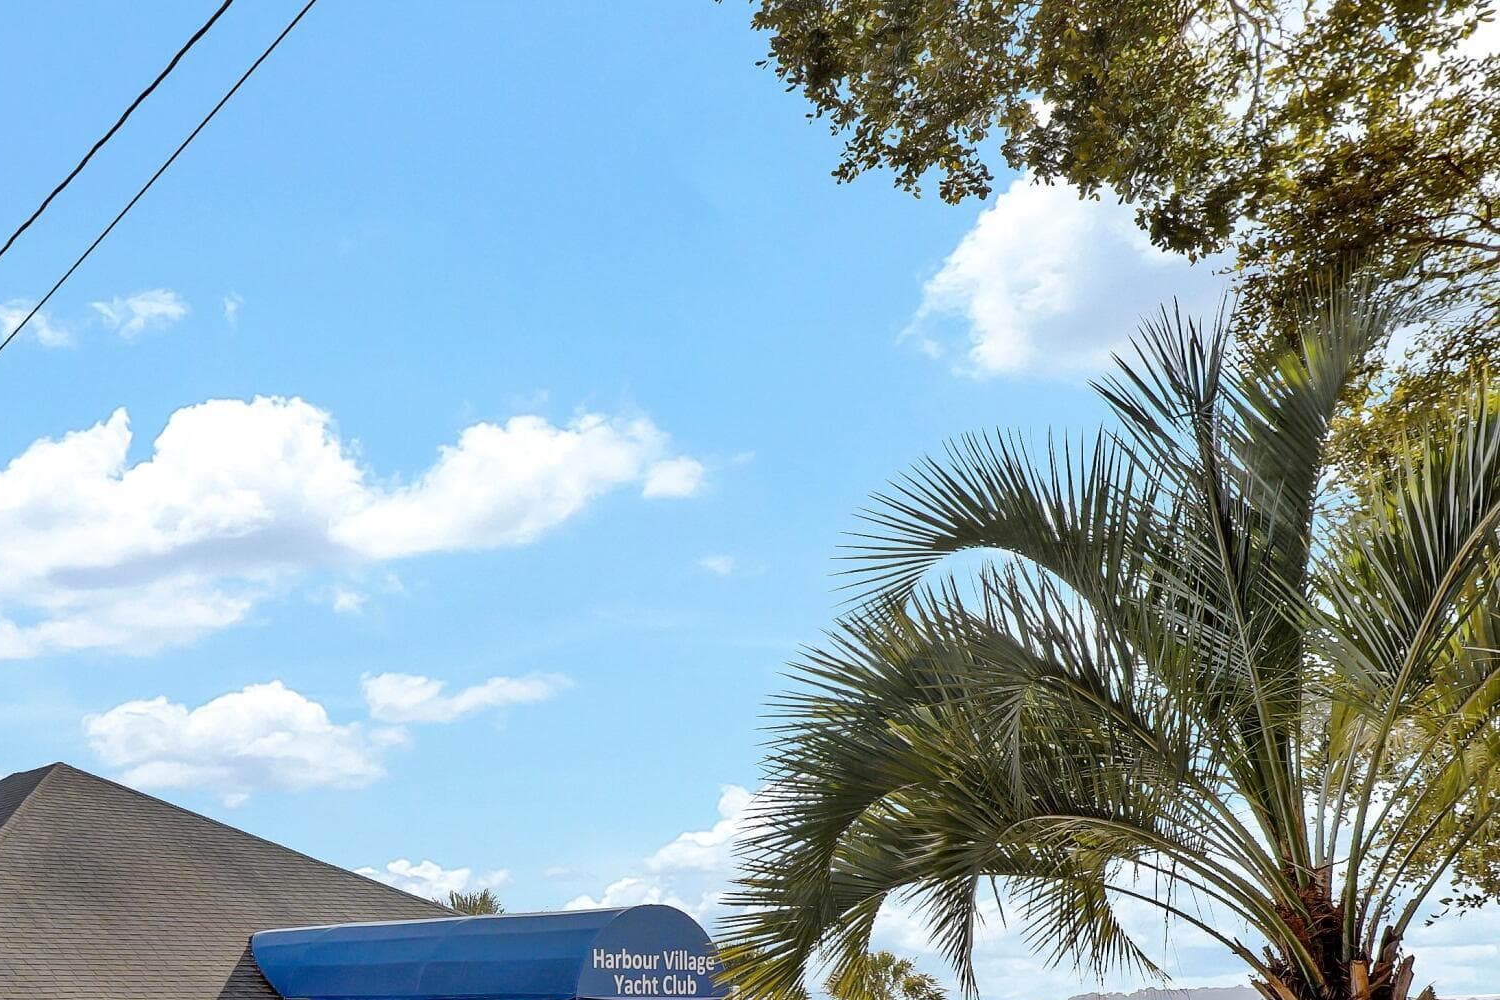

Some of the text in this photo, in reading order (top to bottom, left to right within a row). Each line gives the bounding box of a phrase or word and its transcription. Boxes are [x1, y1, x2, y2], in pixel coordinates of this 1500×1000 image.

[593, 948, 715, 975] Harbour Village
[614, 974, 697, 995] Yacht Club
